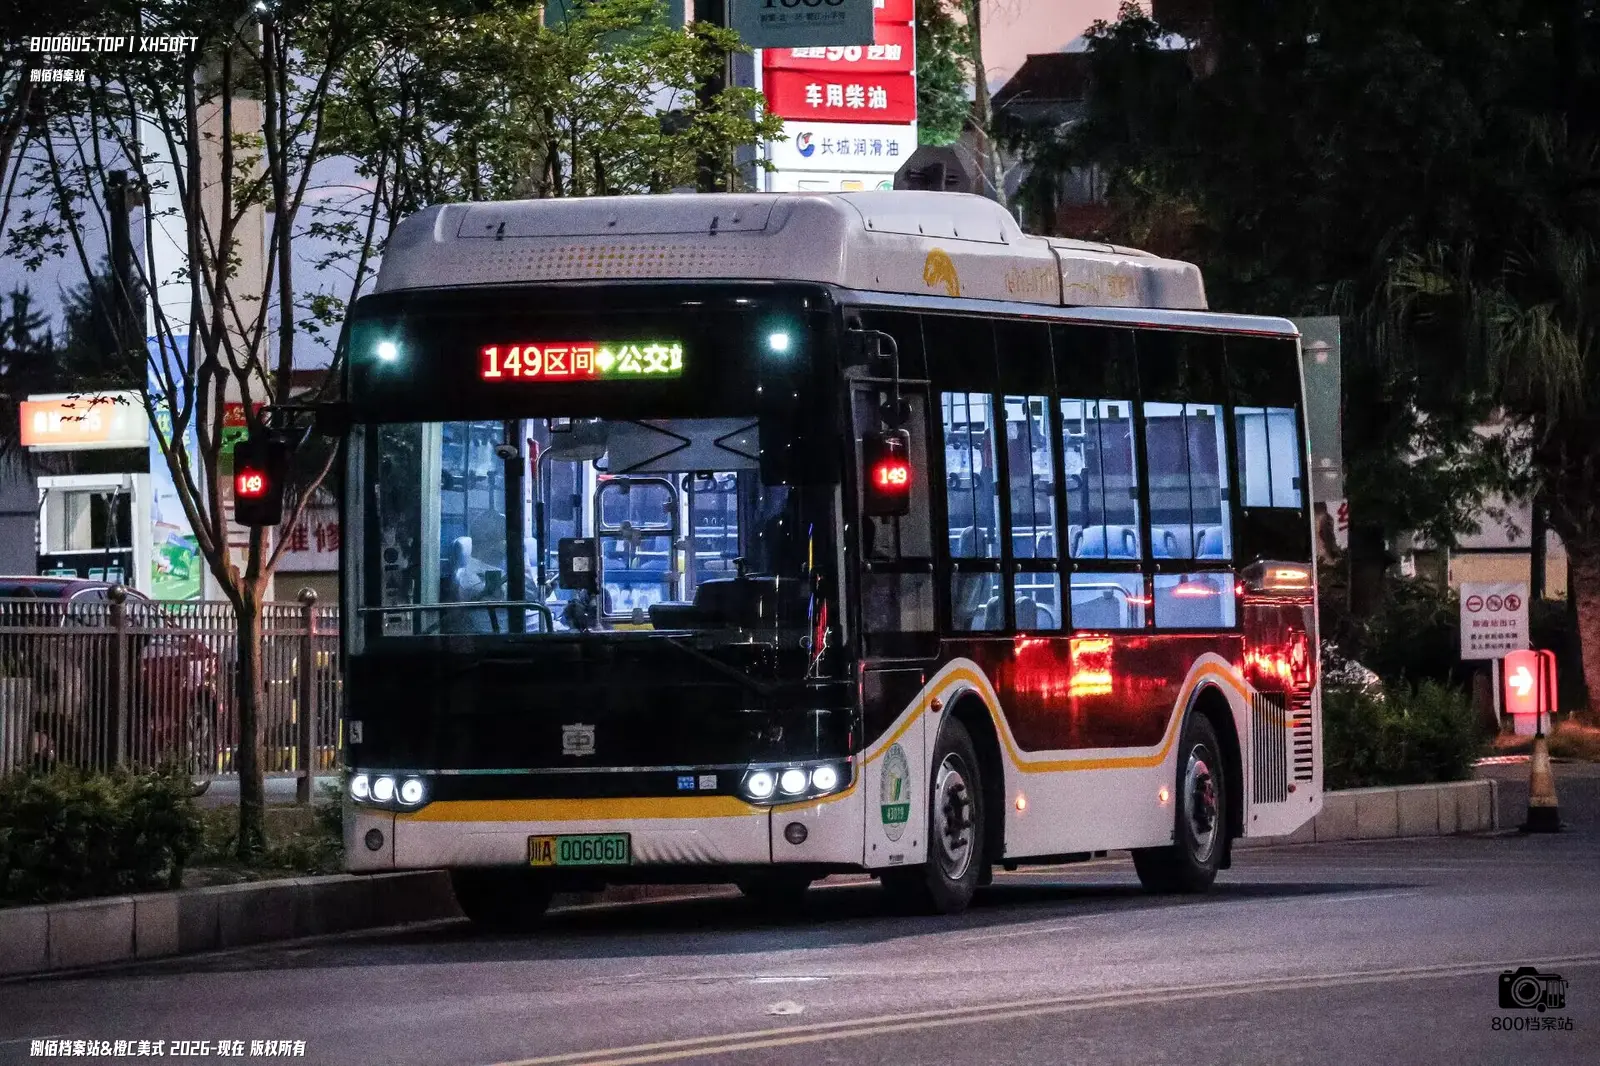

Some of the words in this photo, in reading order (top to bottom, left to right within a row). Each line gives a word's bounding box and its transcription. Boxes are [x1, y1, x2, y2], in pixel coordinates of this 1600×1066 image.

[805, 82, 888, 109] 车用柴油
[821, 136, 899, 157] 长城润滑油
[240, 475, 263, 493] 149
[880, 466, 908, 485] 149
